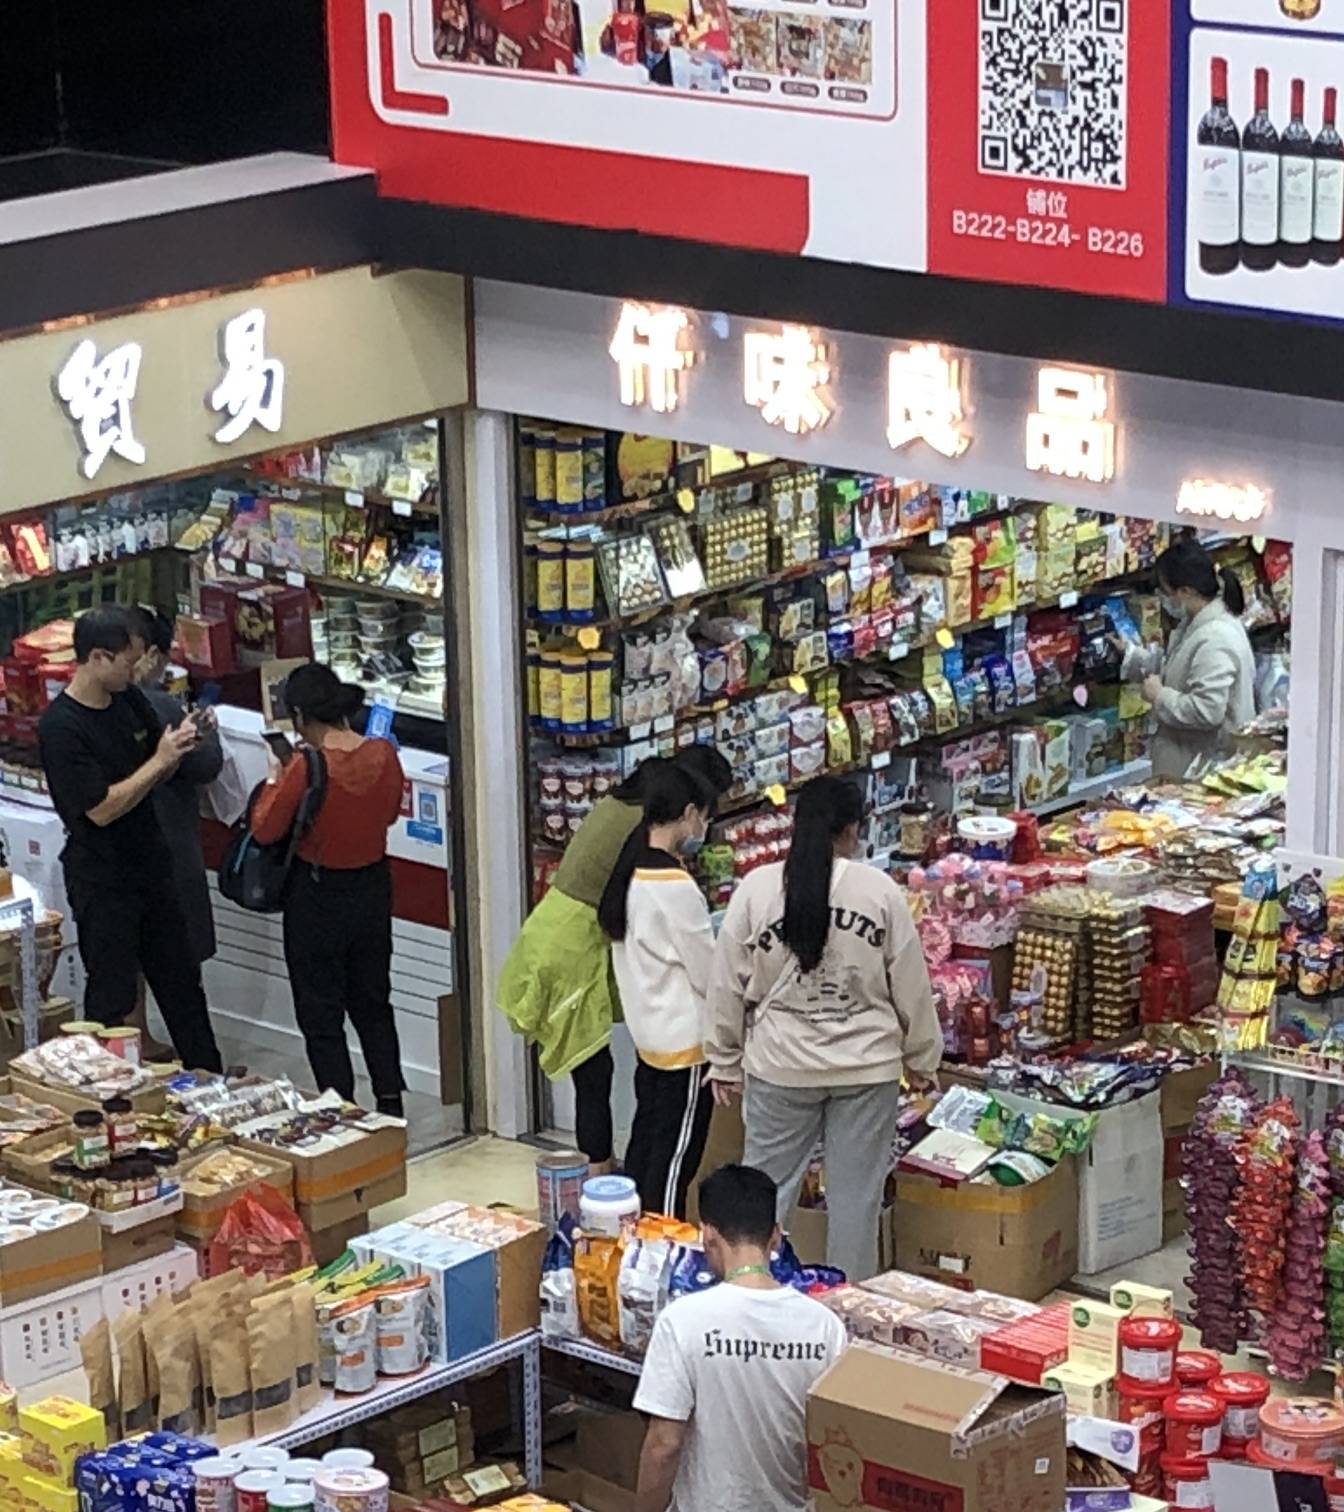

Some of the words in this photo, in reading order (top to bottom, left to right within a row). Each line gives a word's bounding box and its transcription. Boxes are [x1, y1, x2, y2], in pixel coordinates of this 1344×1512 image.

[1025, 187, 1068, 219] 铺位
[1087, 226, 1144, 258] B226
[704, 1327, 826, 1362] Supreme
